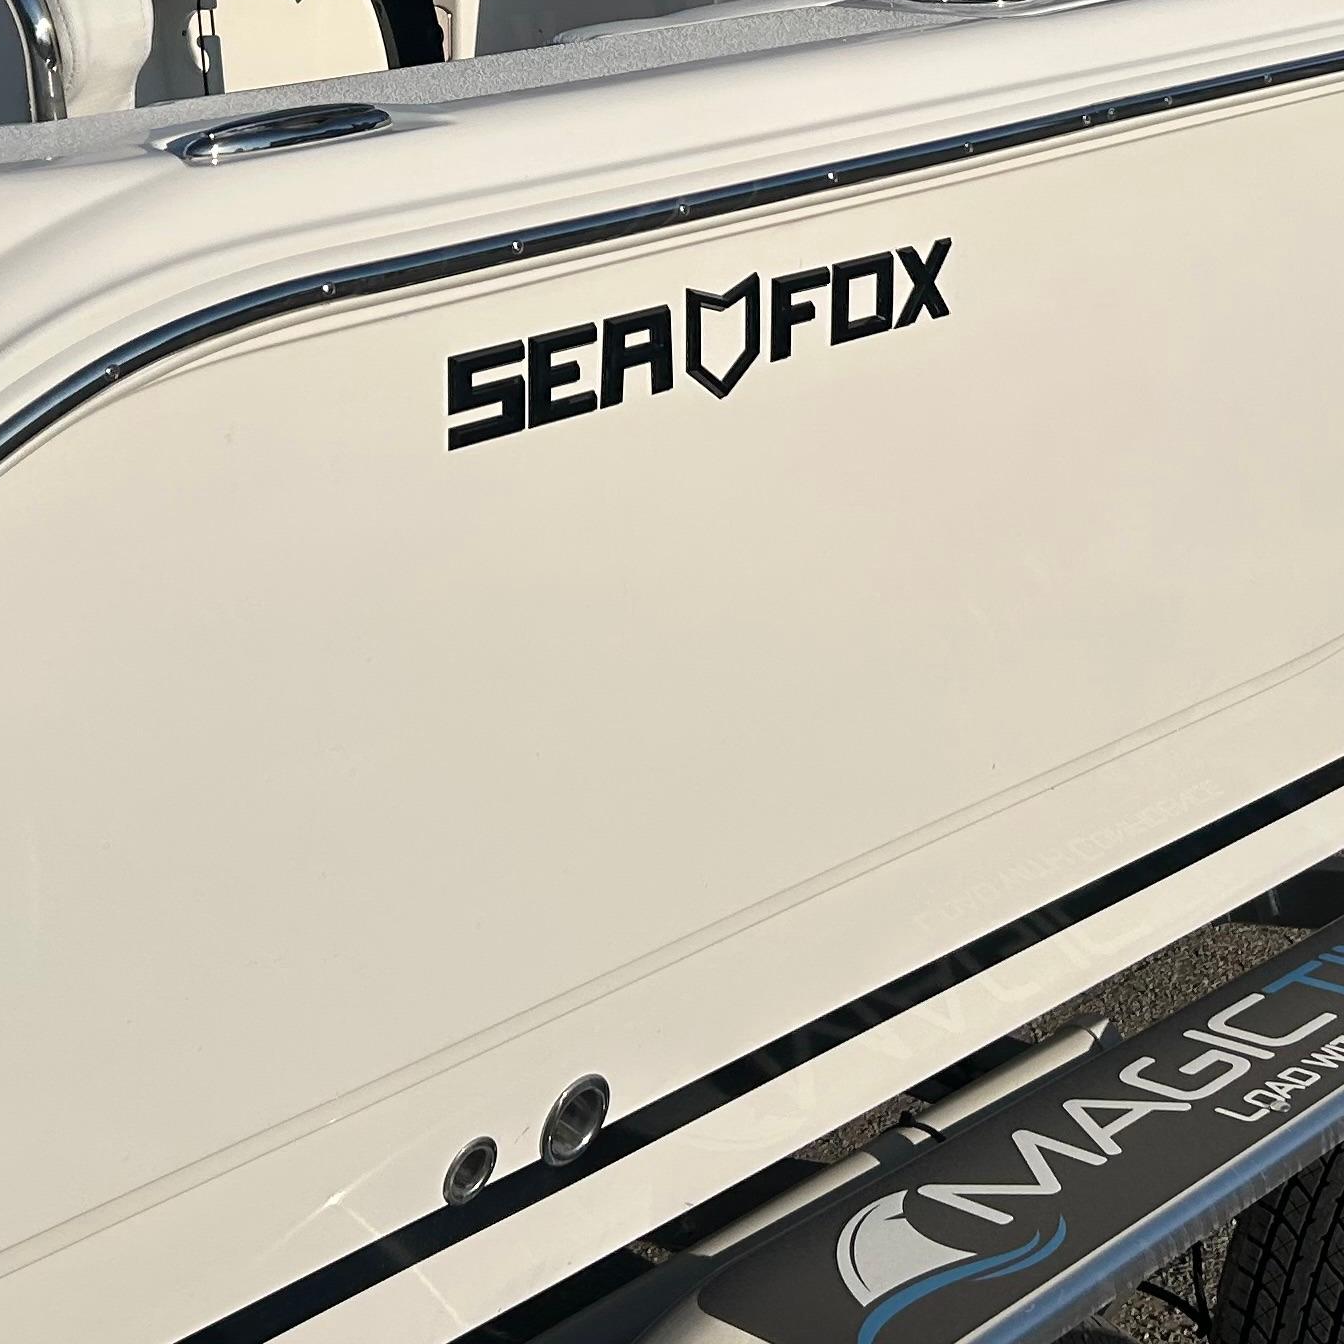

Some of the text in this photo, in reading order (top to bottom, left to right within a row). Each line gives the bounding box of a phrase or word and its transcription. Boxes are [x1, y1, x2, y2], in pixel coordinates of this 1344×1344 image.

[447, 237, 952, 452] SEA FOX
[1214, 1067, 1322, 1122] LOAD
